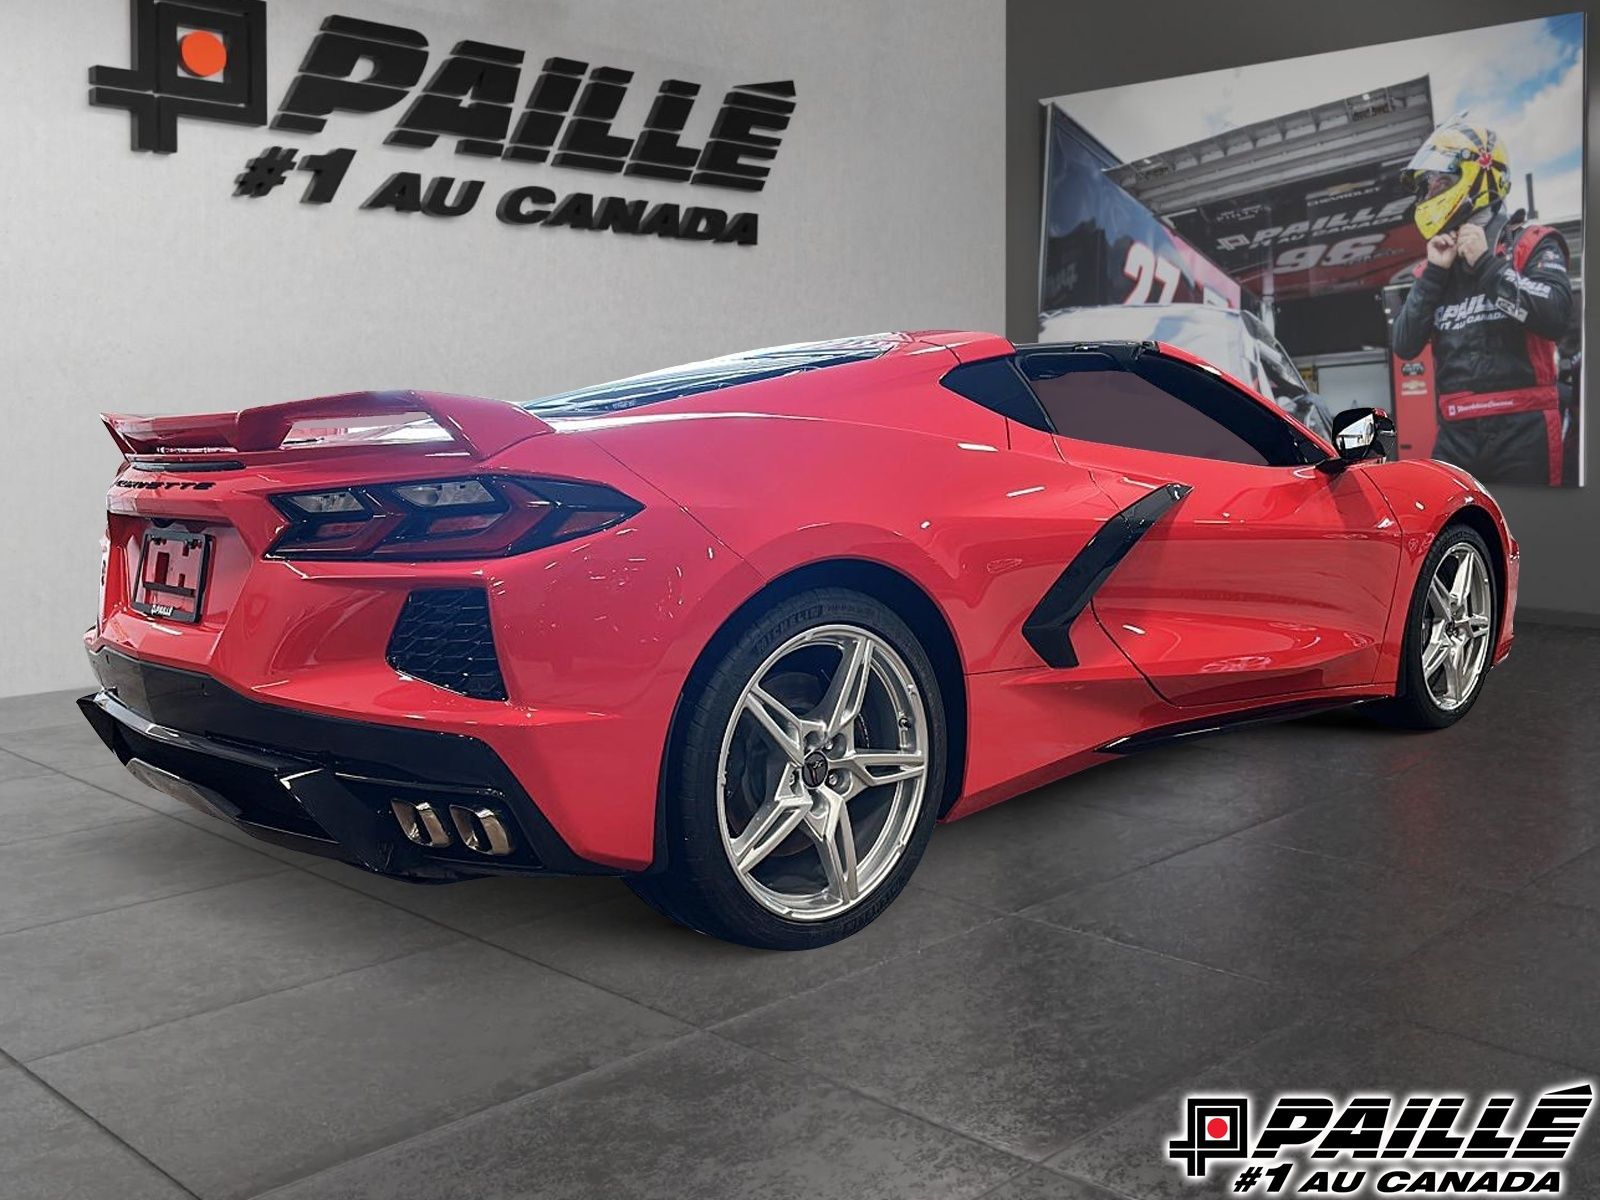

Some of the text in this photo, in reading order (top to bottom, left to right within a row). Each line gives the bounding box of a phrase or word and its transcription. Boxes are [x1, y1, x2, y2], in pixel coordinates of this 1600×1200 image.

[270, 14, 797, 191] PAILLÉ
[231, 146, 760, 247] #1 AU CANADA
[1123, 240, 1181, 305] 27
[1272, 233, 1387, 275] 96
